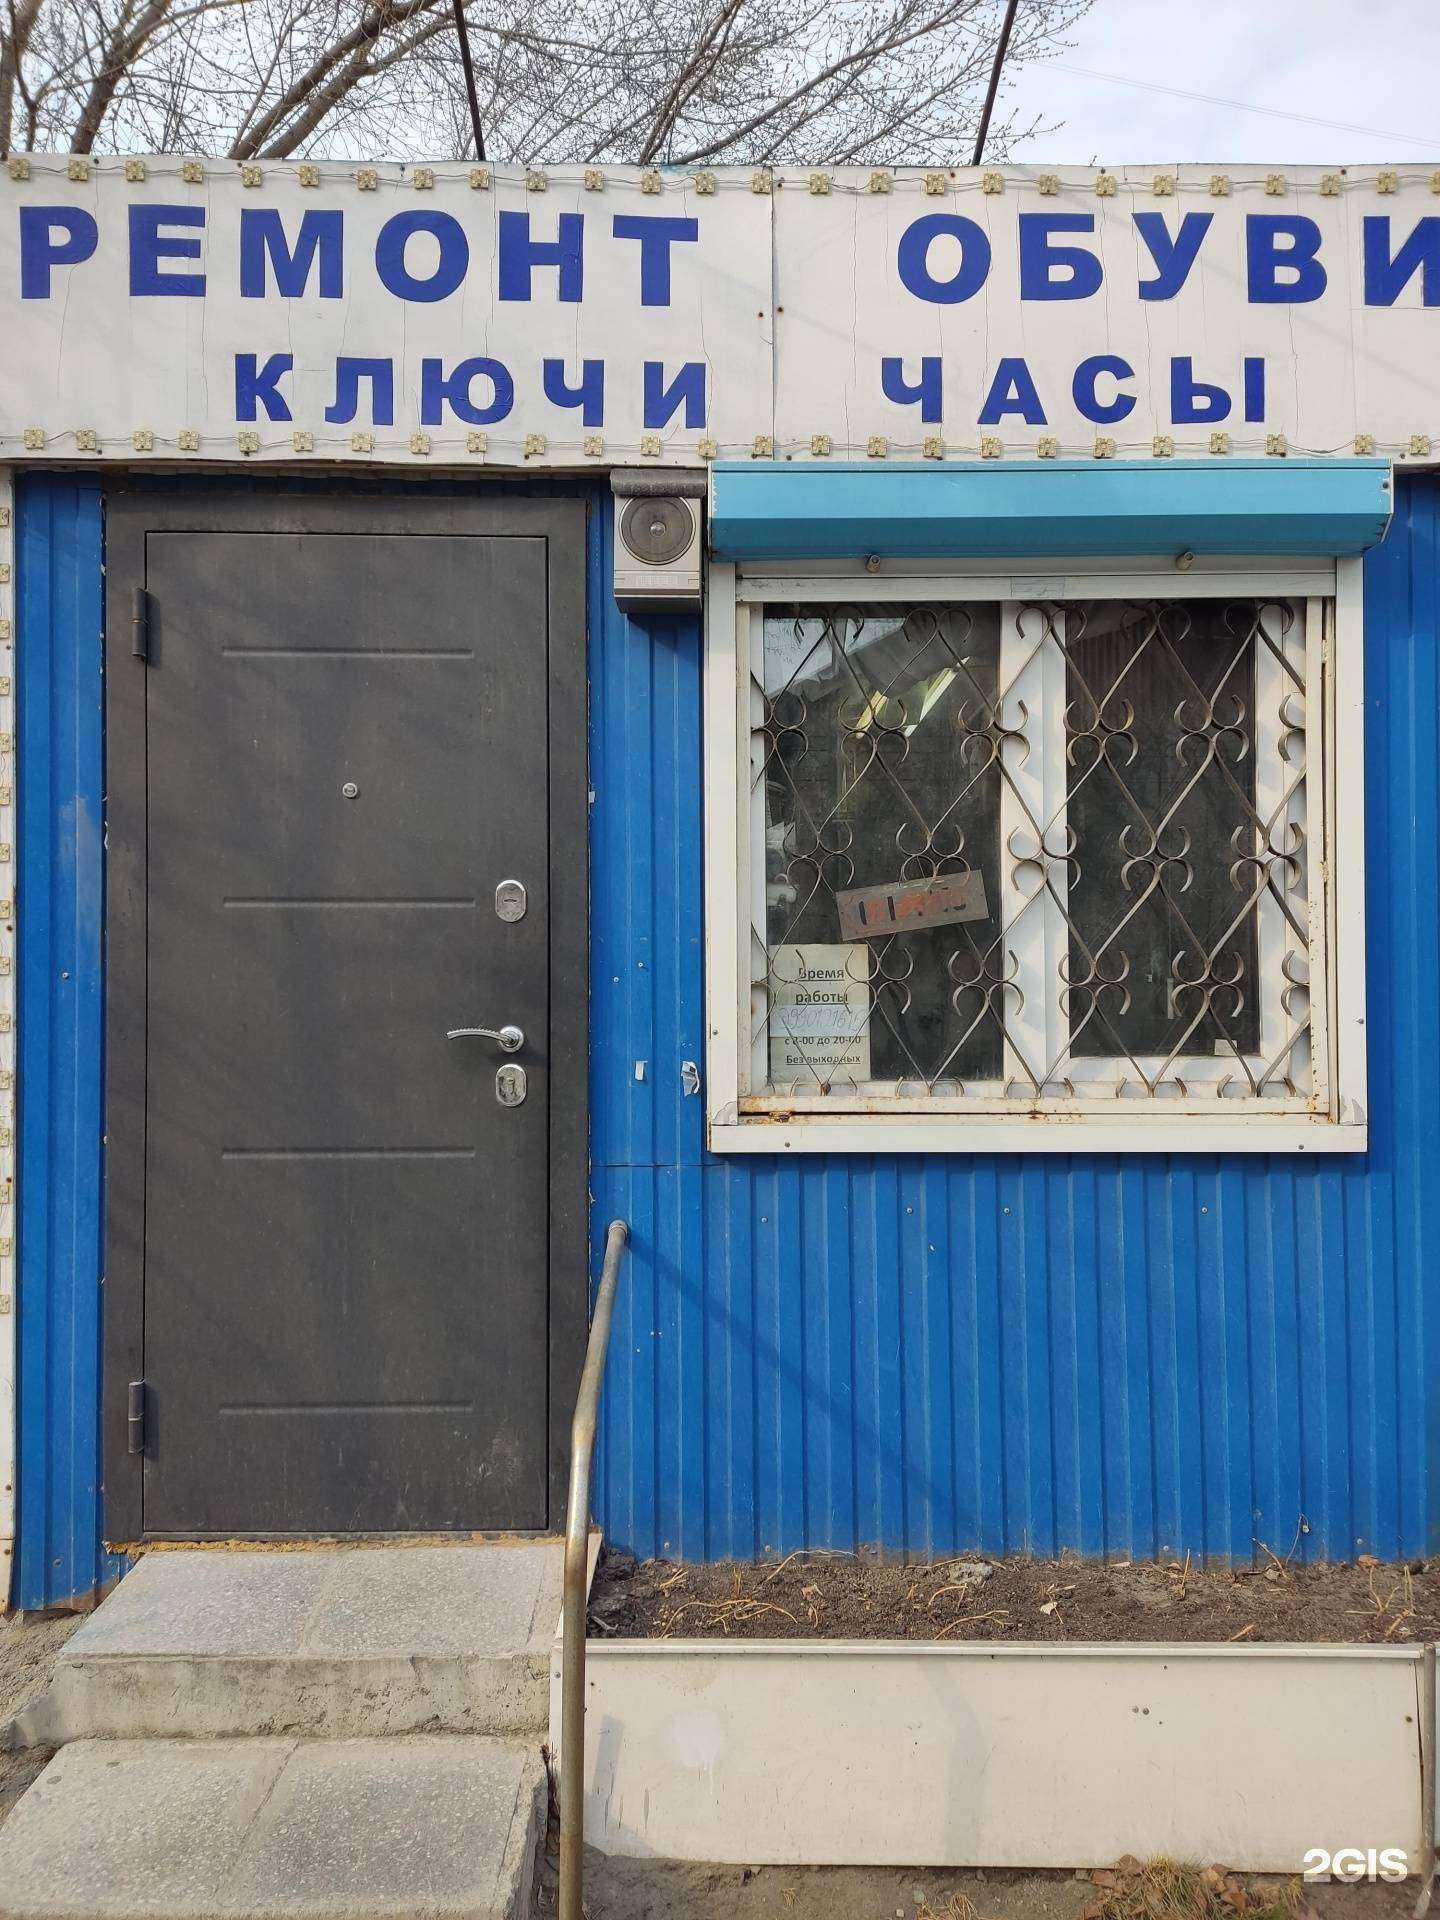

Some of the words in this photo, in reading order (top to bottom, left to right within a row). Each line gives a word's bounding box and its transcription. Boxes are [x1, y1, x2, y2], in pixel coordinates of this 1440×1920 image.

[20, 204, 699, 306] РЕМОНТ
[897, 211, 1440, 307] ОБУВИ
[234, 352, 706, 429] КЛЮЧИ
[881, 354, 1266, 426] ЧАСЫ
[795, 990, 849, 1004] работы
[817, 1037, 830, 1047] до
[786, 1055, 804, 1064] Без
